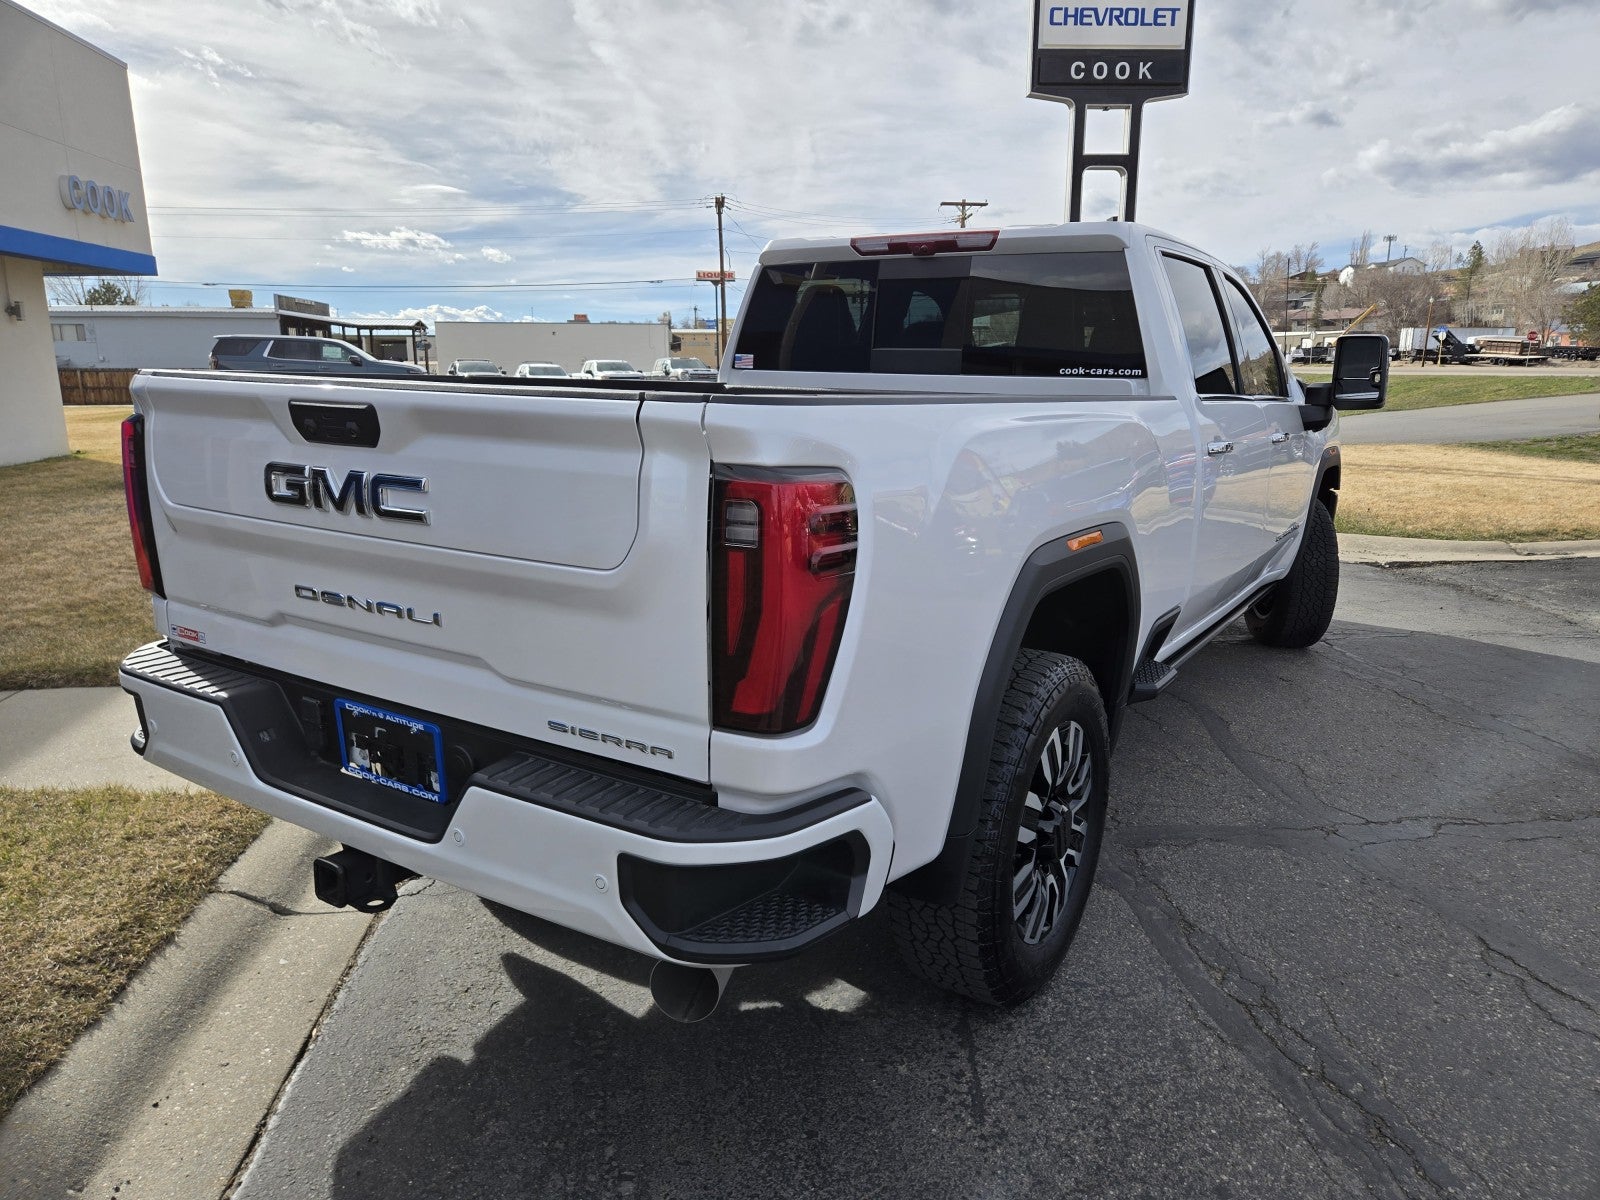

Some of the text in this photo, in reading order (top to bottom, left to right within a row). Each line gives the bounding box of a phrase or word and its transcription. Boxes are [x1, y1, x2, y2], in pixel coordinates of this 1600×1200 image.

[1050, 7, 1180, 26] CHEVROLET
[1070, 61, 1154, 80] COOK
[58, 174, 135, 223] COOK
[1059, 366, 1142, 376] cook-cars.com
[264, 460, 432, 526] GMC
[294, 583, 443, 627] DENALI
[386, 714, 424, 730] ALTITUDE
[547, 720, 675, 759] SIERRA
[347, 766, 440, 803] COOK-CARS.COM
